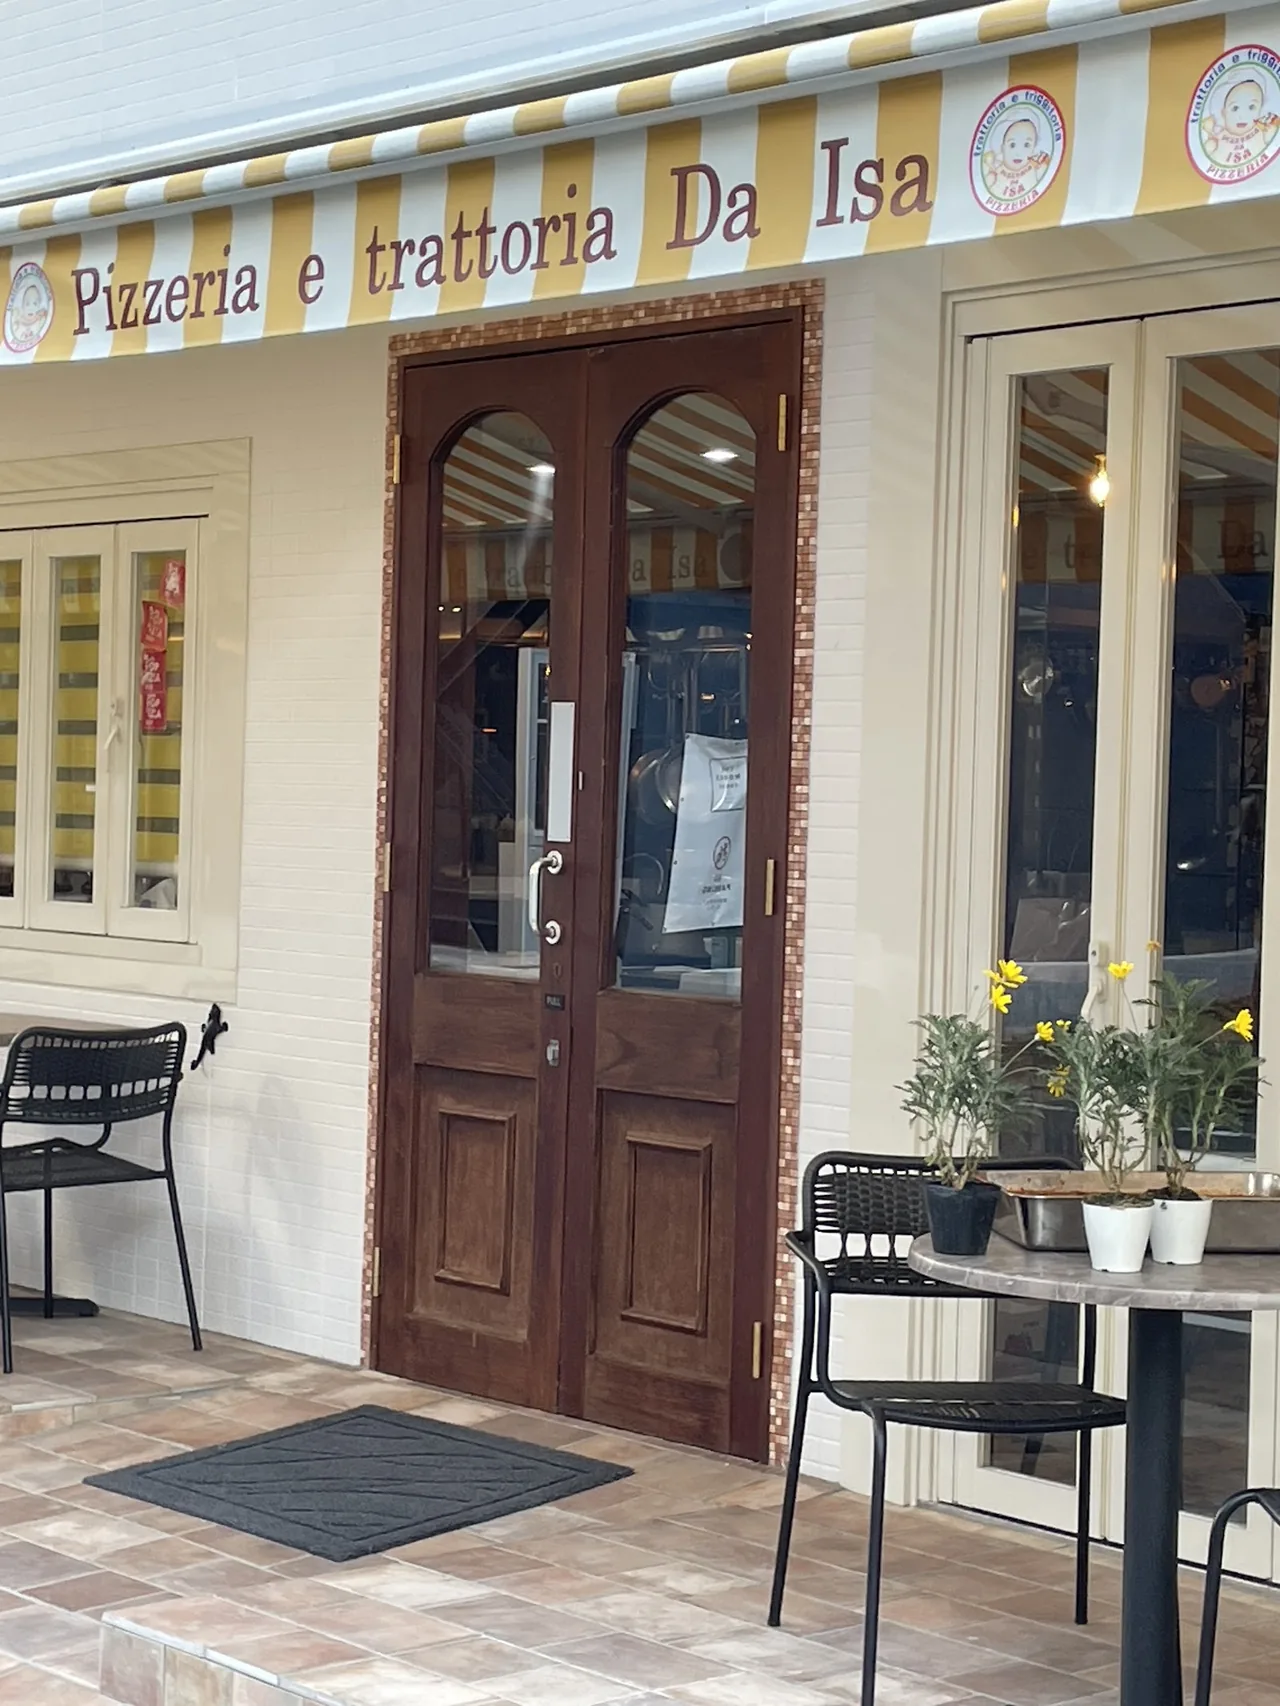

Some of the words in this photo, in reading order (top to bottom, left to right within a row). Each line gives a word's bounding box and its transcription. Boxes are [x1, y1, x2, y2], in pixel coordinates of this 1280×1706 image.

[1190, 62, 1226, 124] trattoria
[1232, 54, 1240, 64] e
[973, 101, 1006, 157] trattoria
[1011, 94, 1019, 103] e
[1206, 153, 1270, 179] PIZZERIA
[985, 189, 1040, 212] PIZZERIA
[71, 245, 260, 336] Pizzeria
[300, 254, 325, 304] e
[365, 184, 616, 295] trattoria
[666, 163, 761, 250] Da
[816, 137, 932, 228] Isa
